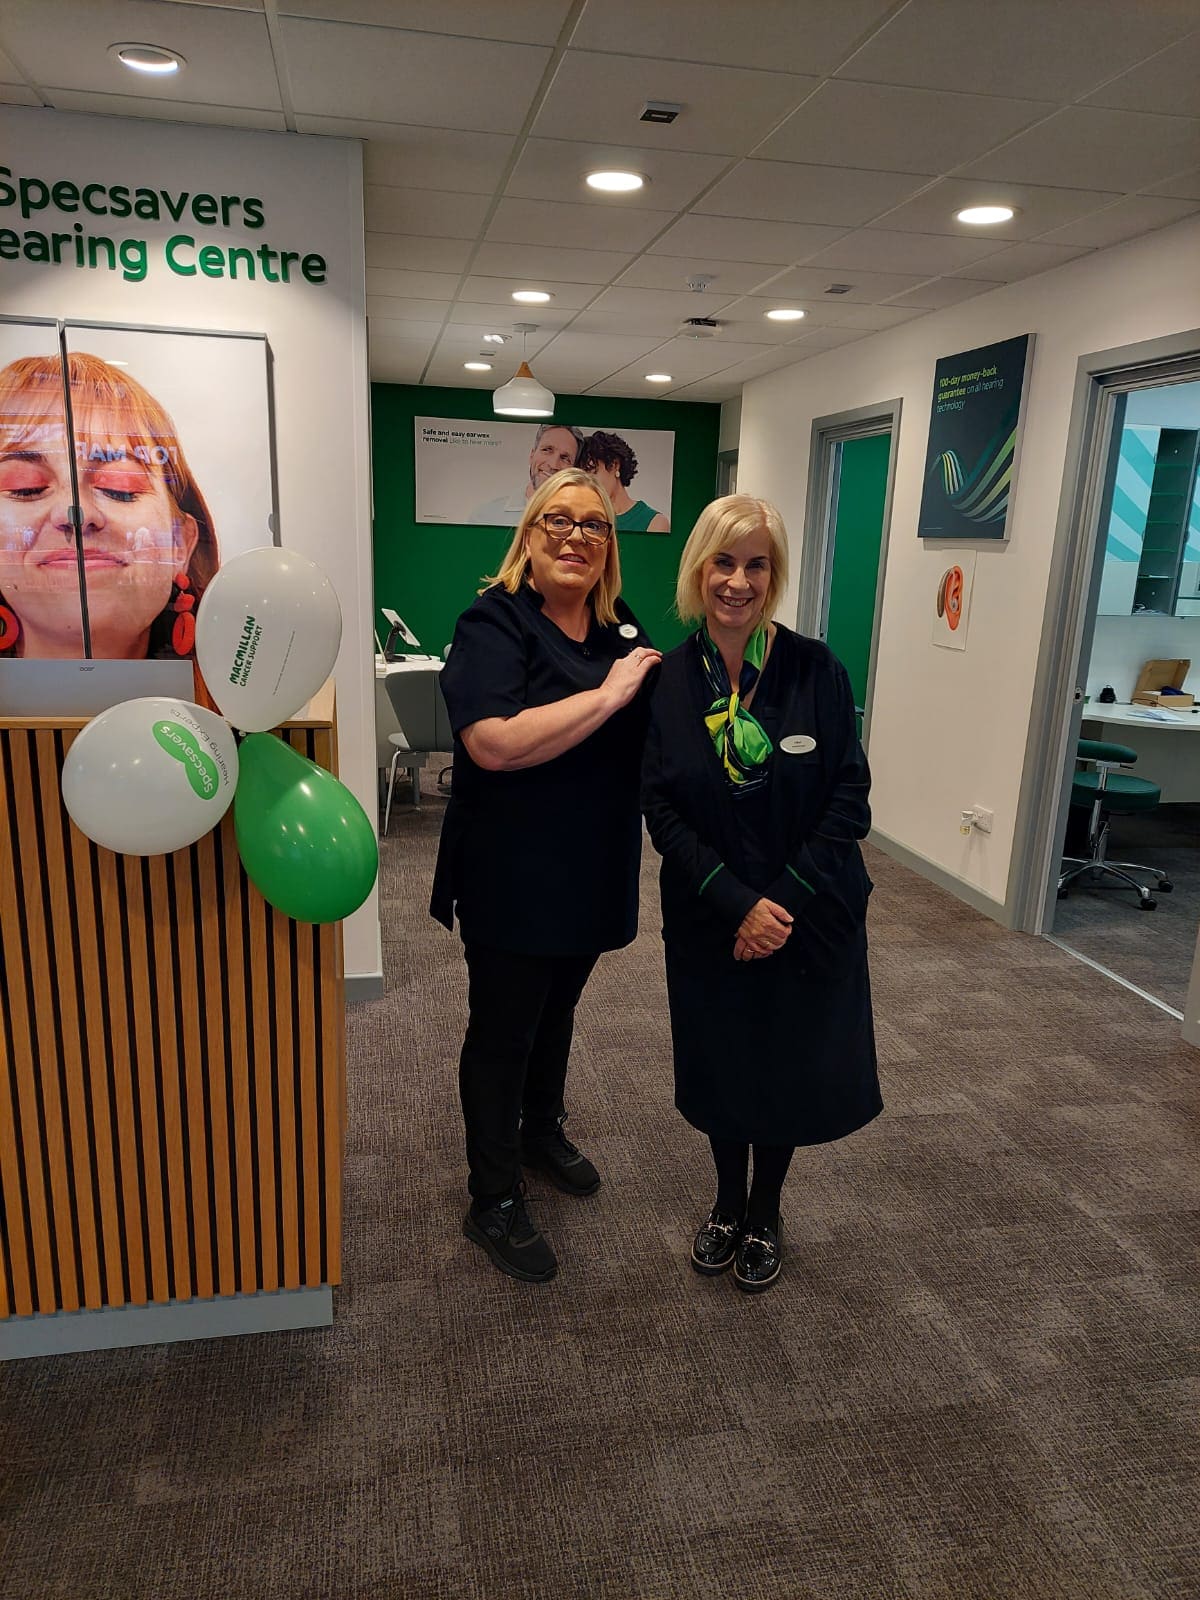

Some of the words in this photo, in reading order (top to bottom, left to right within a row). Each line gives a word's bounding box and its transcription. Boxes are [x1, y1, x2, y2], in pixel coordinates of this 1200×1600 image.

[0, 166, 265, 229] Specsavers
[165, 234, 327, 284] Centre
[961, 364, 997, 382] money-back
[937, 400, 965, 413] technology
[938, 388, 966, 403] guarantee
[422, 428, 437, 436] Safe
[229, 615, 255, 684] MACMILLAN
[240, 660, 252, 687] CANCER
[248, 625, 262, 660] SUPPORT
[170, 708, 210, 742] Experts
[160, 726, 213, 793] Specsavers
[209, 742, 230, 786] Hearing
